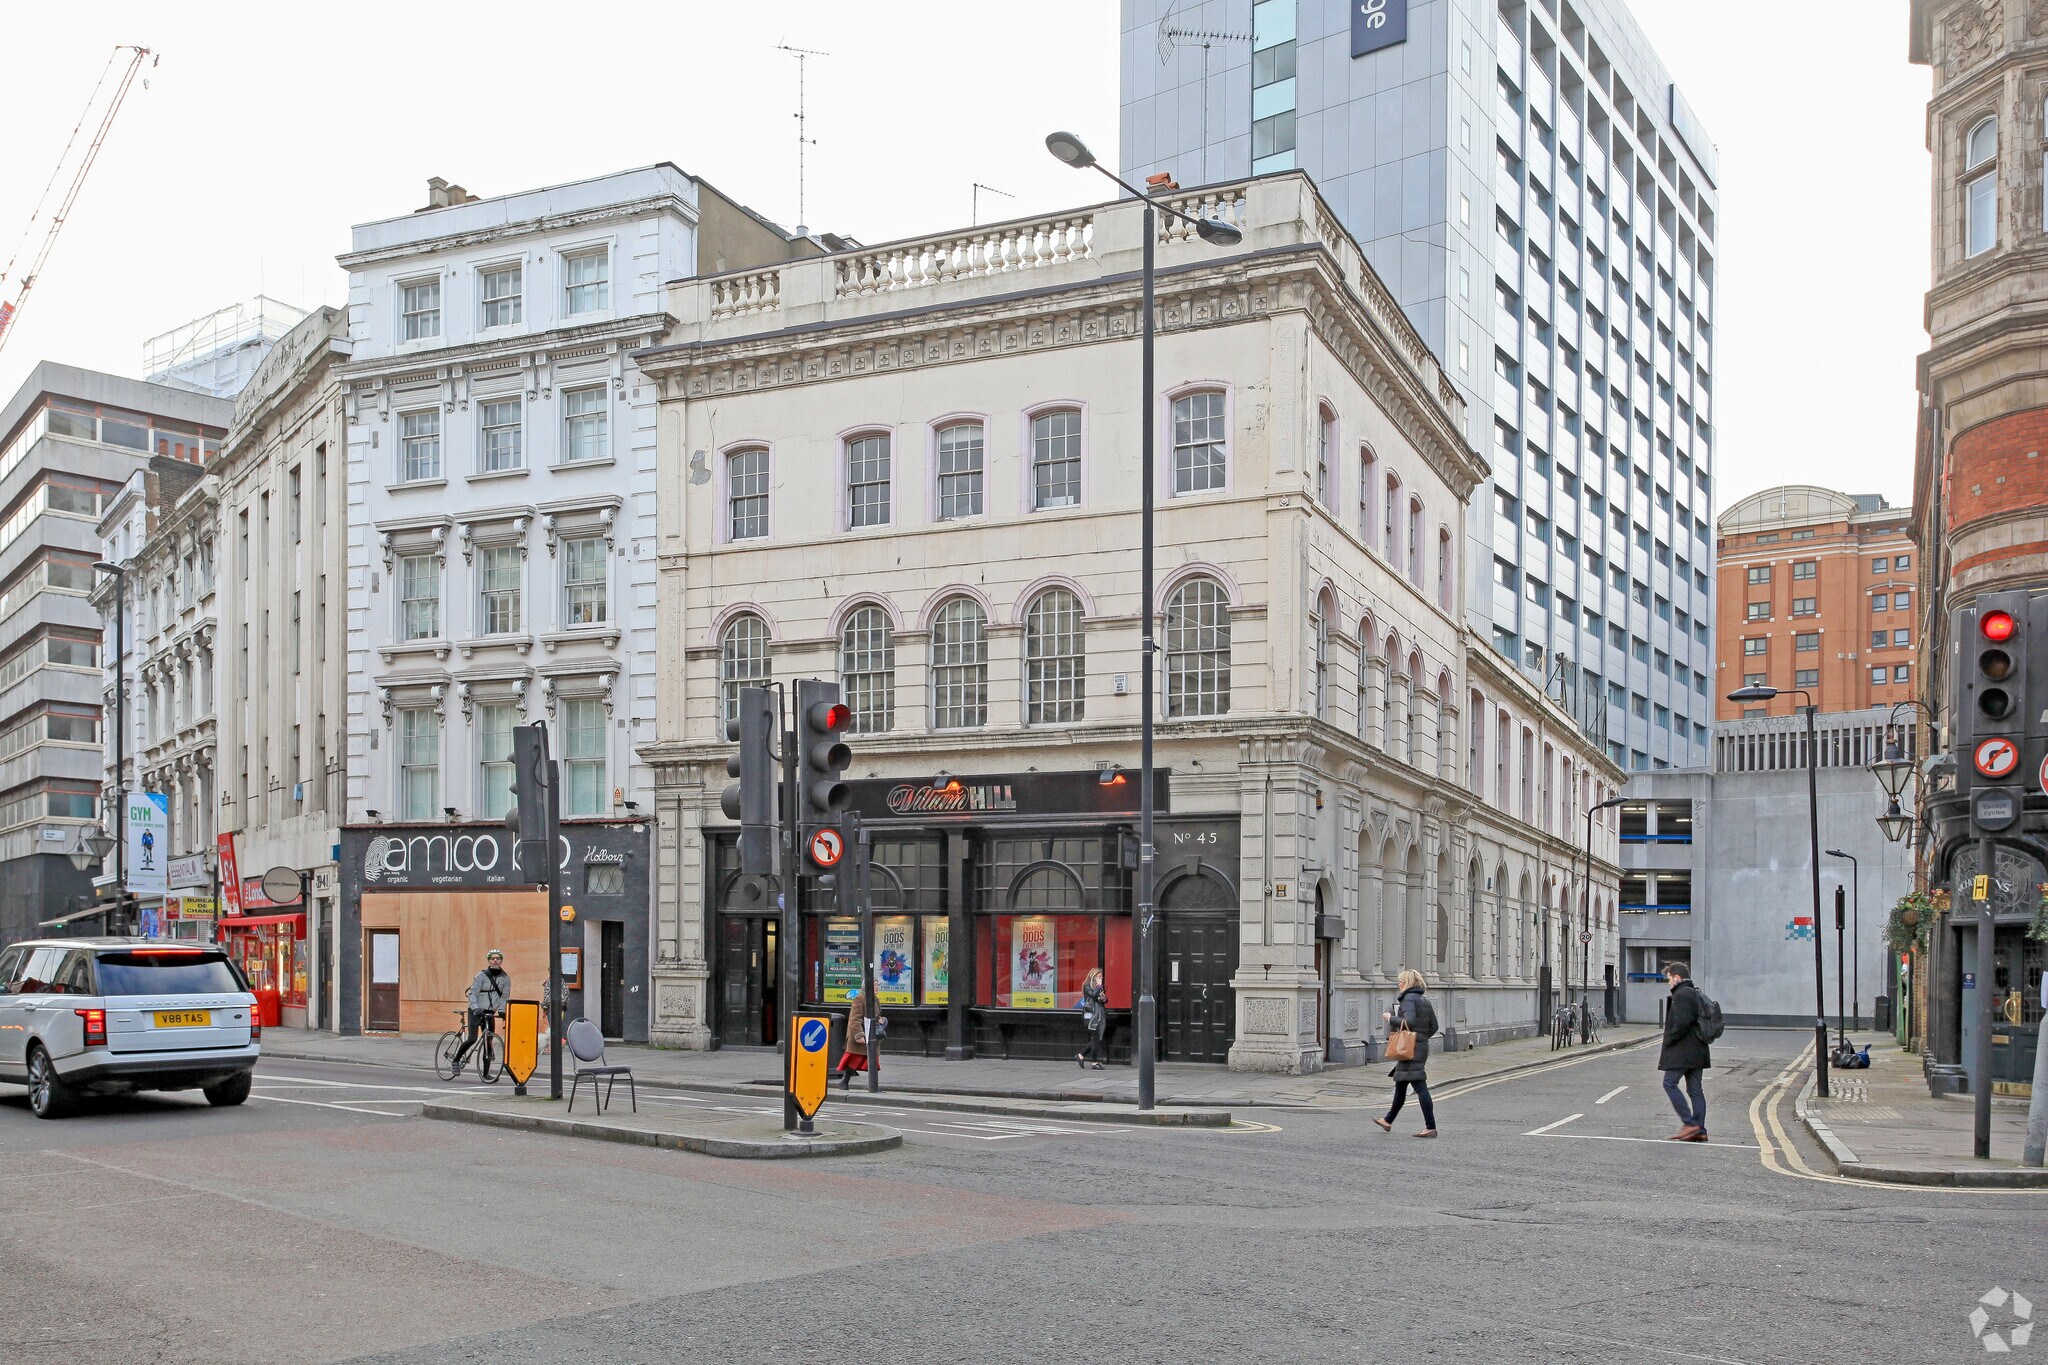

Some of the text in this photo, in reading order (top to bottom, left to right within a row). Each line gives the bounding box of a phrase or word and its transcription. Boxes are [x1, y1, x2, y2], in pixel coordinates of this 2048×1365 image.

[969, 785, 1017, 810] HILL
[130, 806, 151, 821] GYM
[1983, 803, 2007, 811] Except
[1197, 832, 1217, 844] 45
[384, 830, 499, 872] amico
[584, 846, 624, 862] Holborn
[1276, 884, 1287, 897] H
[1976, 878, 1985, 897] H
[884, 933, 904, 945] ODDS
[1023, 931, 1045, 943] ODDS
[162, 1014, 203, 1023] V88 TAS
